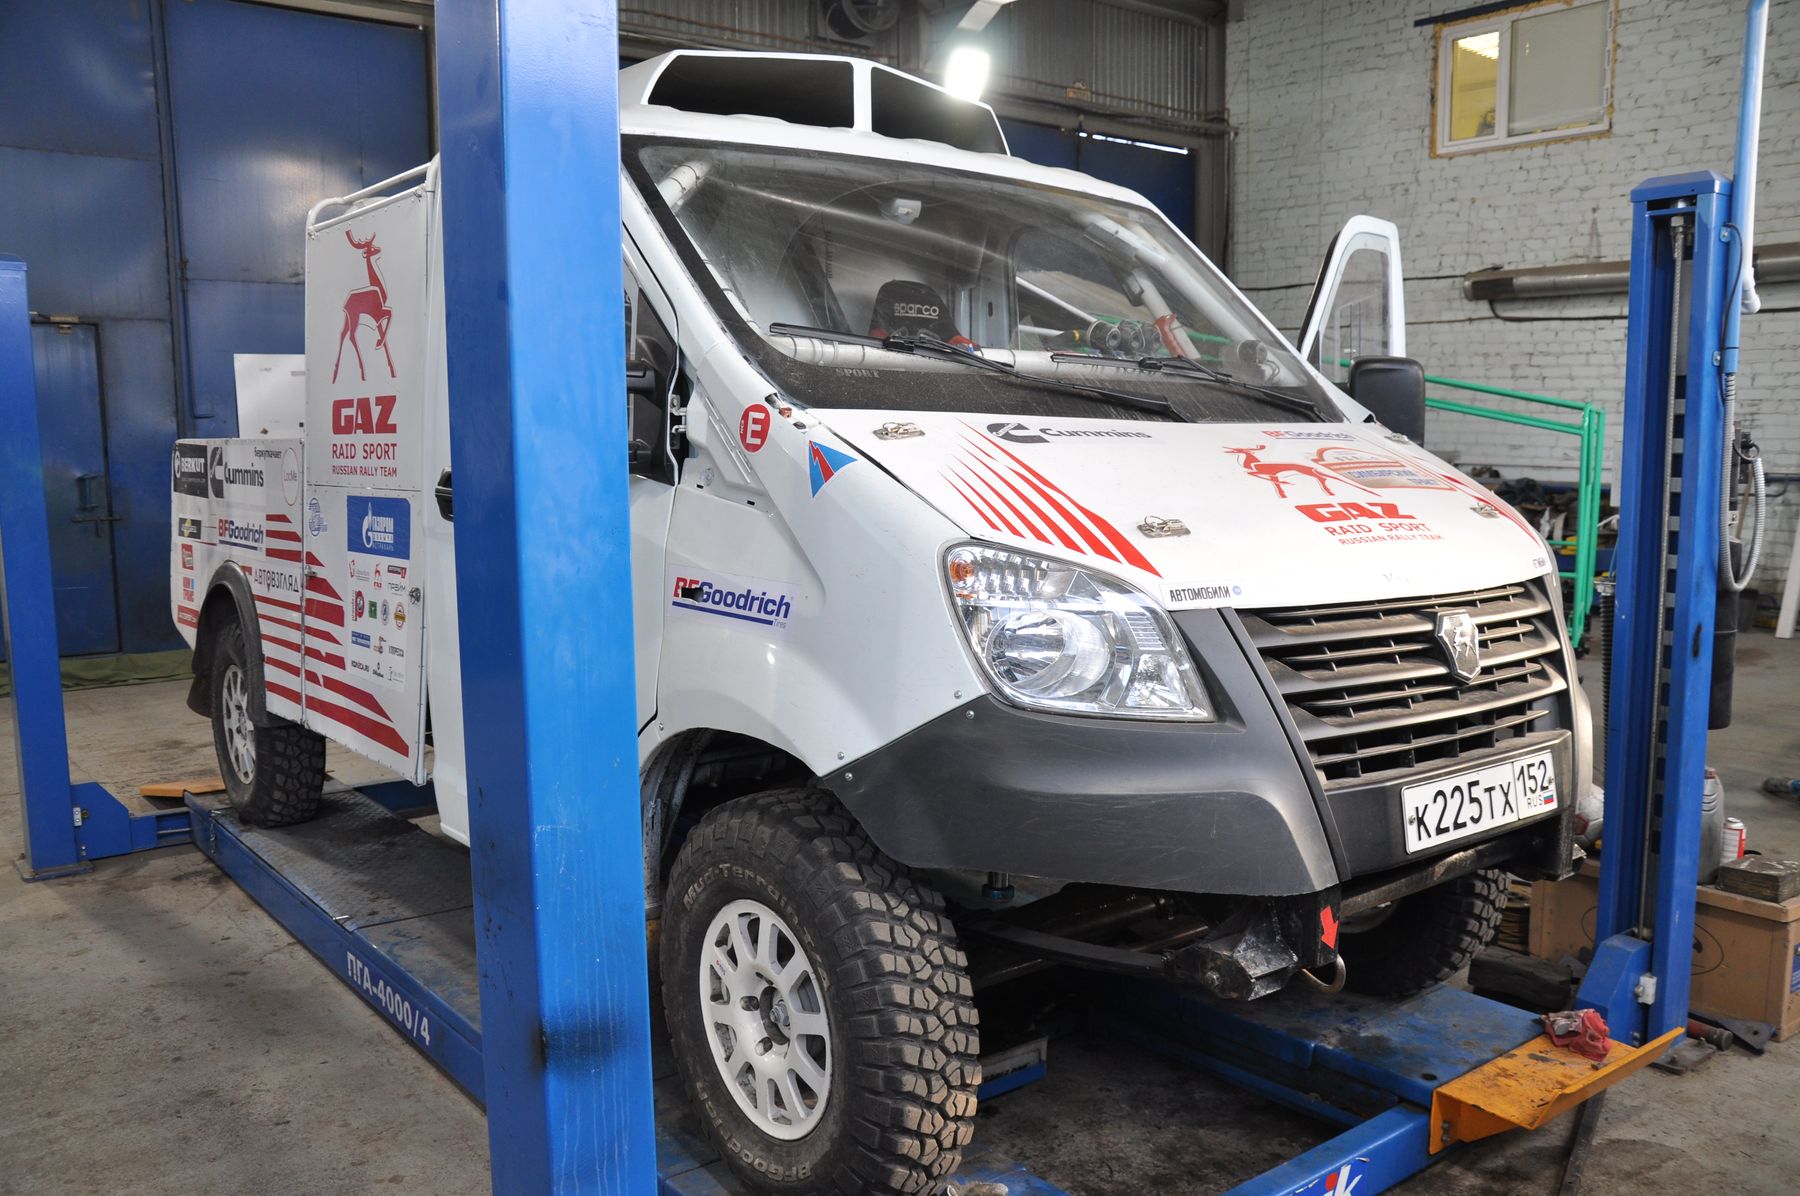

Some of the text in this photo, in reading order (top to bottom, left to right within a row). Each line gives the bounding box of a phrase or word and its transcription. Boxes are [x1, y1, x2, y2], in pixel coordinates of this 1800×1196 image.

[894, 302, 940, 317] sparco
[835, 367, 881, 379] SPORT
[332, 395, 398, 435] GAZ
[746, 411, 766, 445] E
[1039, 427, 1153, 439] Cummins
[1261, 430, 1357, 440] BFGoodrich
[332, 443, 397, 460] RAID SPORT
[181, 457, 205, 473] BERKUT
[332, 465, 397, 478] RUSSIAN RALLY TEAM
[224, 462, 264, 487] Cummins
[1294, 502, 1417, 523] GAZ
[218, 518, 264, 545] BFGoodrich
[1324, 522, 1432, 536] RAID SPORT
[1338, 533, 1446, 546] RUSSIAN RALLY TEAM
[1170, 585, 1231, 602] АВТОМОБИЛИ
[773, 618, 787, 629] Tires
[1517, 760, 1549, 797] 152
[1527, 794, 1543, 809] RUS
[346, 951, 430, 1047] ПГА-4000/4
